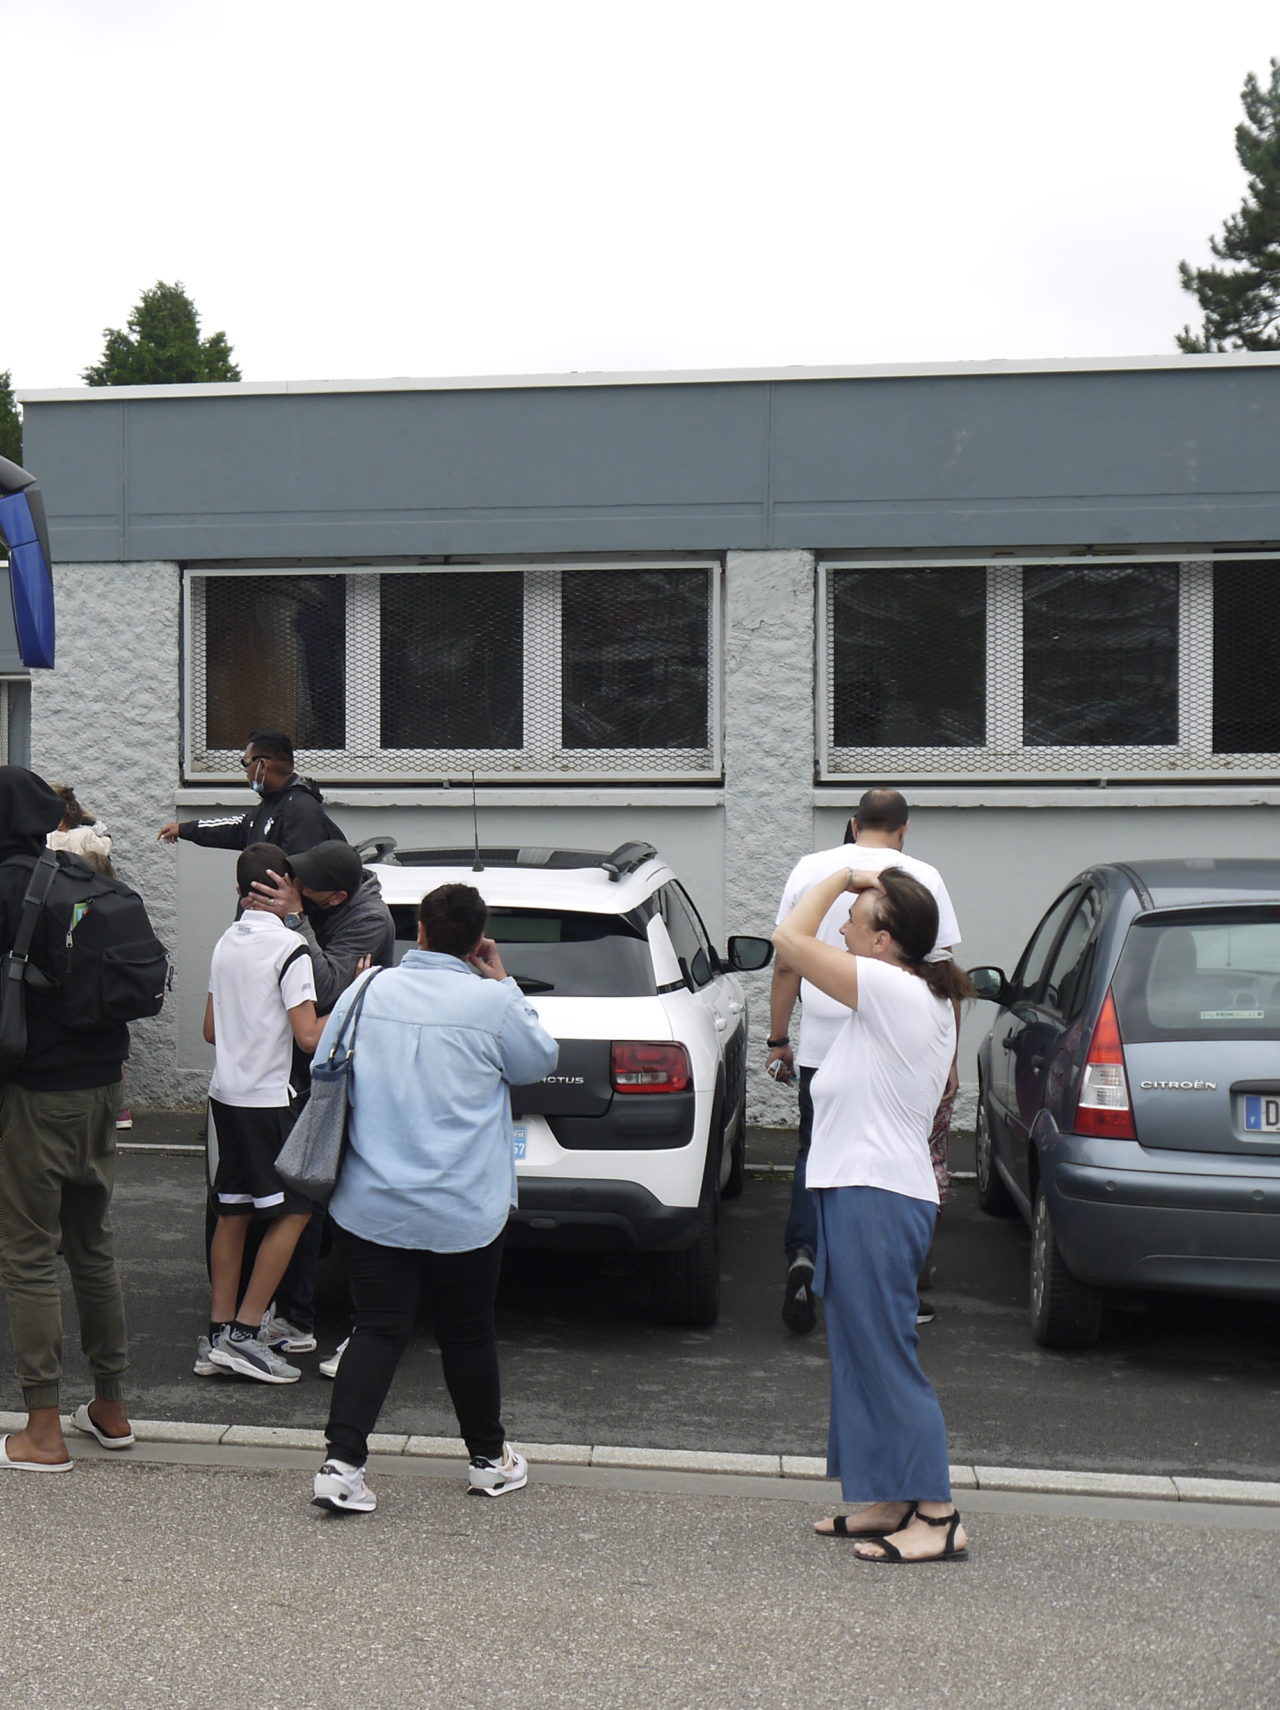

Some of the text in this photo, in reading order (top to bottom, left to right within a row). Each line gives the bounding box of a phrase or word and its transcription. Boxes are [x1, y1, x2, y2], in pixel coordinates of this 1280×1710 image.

[540, 1076, 584, 1084] CTUS
[1140, 1080, 1217, 1090] CITROËN
[1266, 1100, 1279, 1126] D
